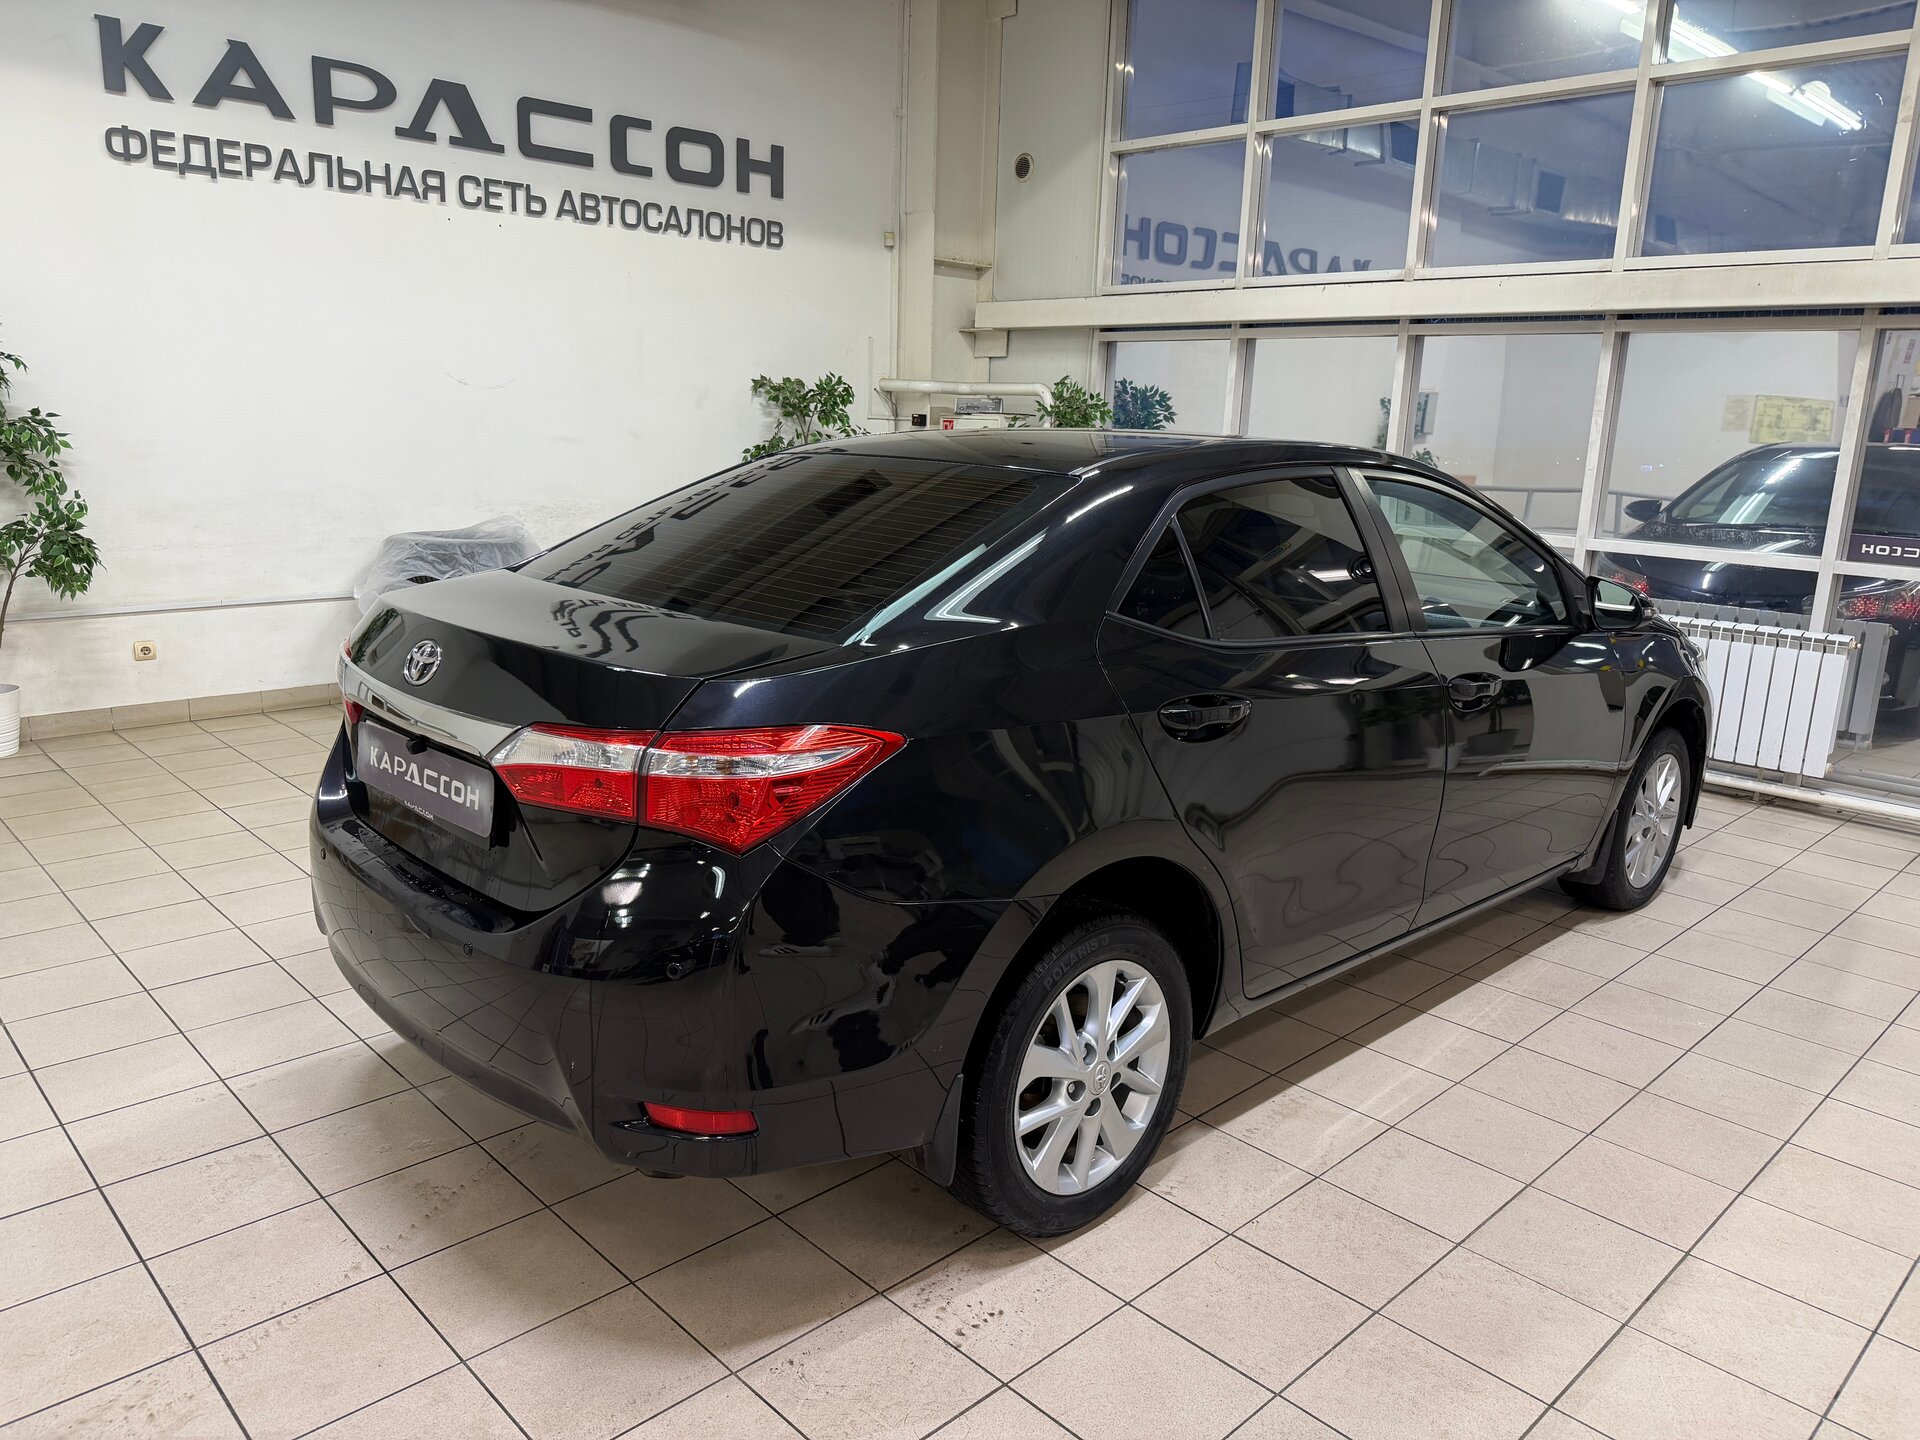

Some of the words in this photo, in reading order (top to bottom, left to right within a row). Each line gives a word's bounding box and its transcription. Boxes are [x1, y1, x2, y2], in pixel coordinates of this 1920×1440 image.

[94, 13, 784, 199] КАРАССОН
[105, 125, 447, 203] ФЕДЕРАЛЬНАЯ
[458, 175, 547, 216] СЕТЬ
[556, 189, 784, 249] АВТОСАЛОНОВ
[370, 746, 480, 811] КАРАССОН
[1044, 937, 1099, 991] POLARIS
